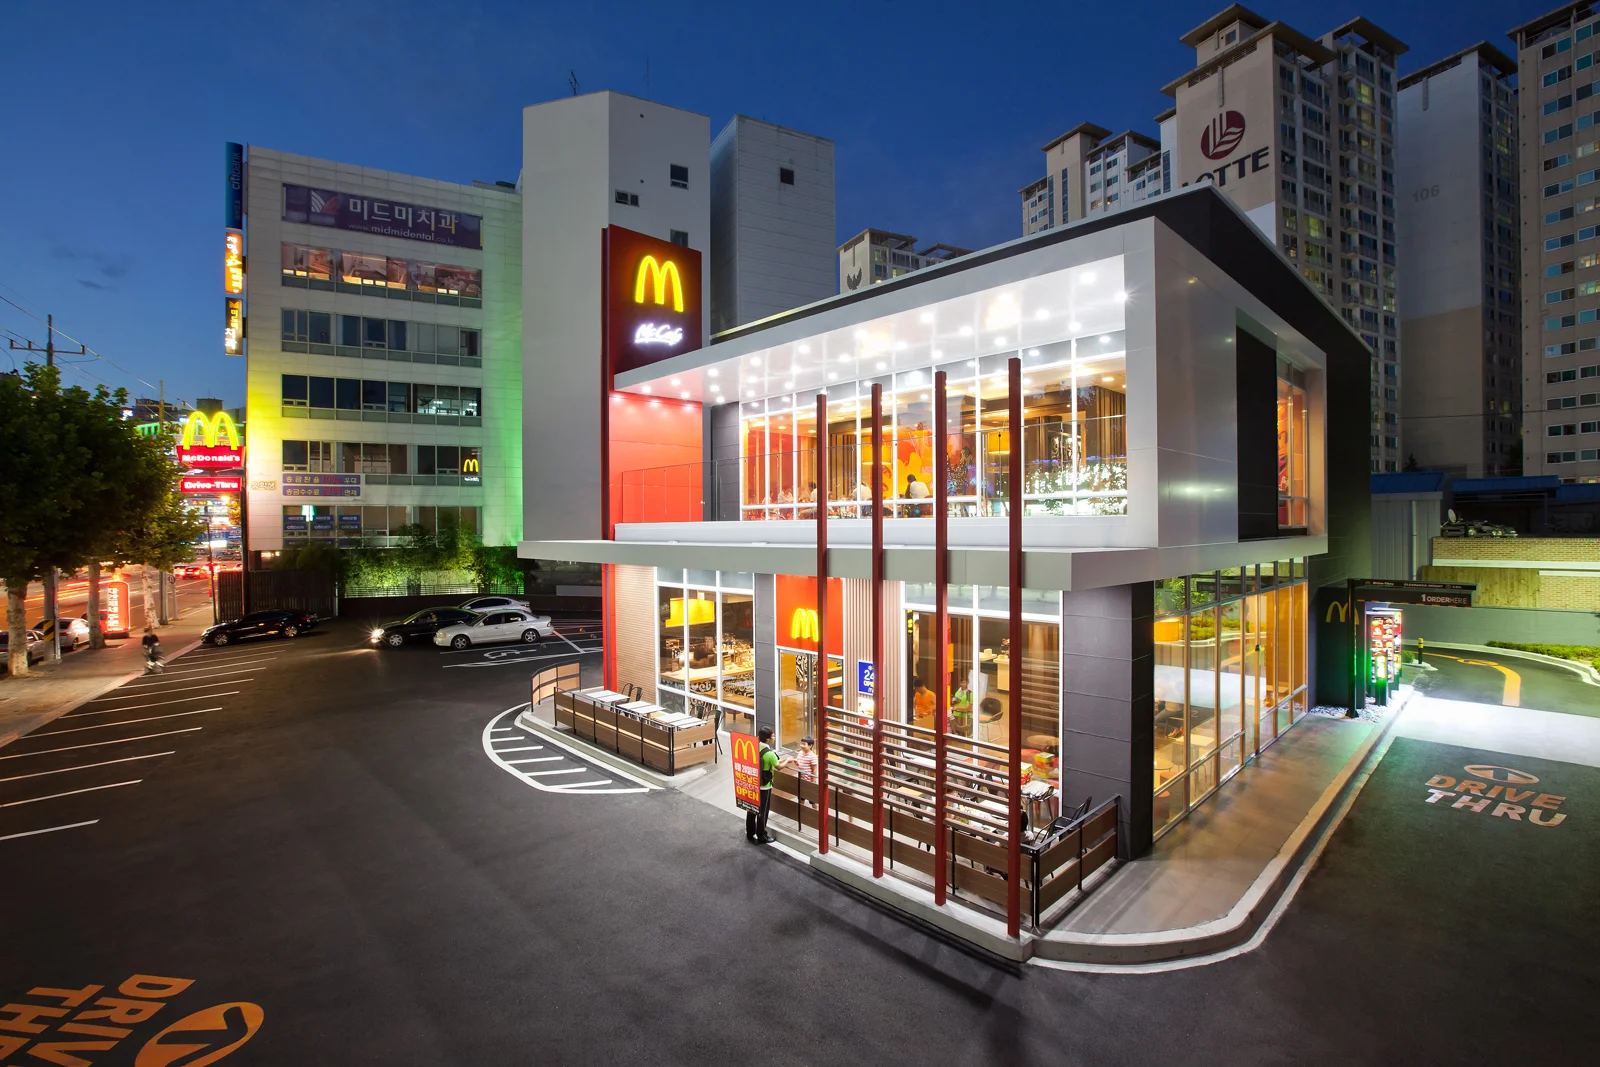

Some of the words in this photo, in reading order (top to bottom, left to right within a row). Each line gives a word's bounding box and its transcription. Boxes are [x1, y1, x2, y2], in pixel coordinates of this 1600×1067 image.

[349, 198, 458, 235] 미드미치과
[348, 223, 454, 244] www.midmidental.co.kr
[182, 454, 240, 462] McDonald's
[184, 481, 238, 489] Drive-Thru
[736, 786, 759, 802] OPEN
[1425, 774, 1566, 810] DRIVE
[1425, 788, 1567, 827] THRU
[6, 973, 196, 1067] DRIV
